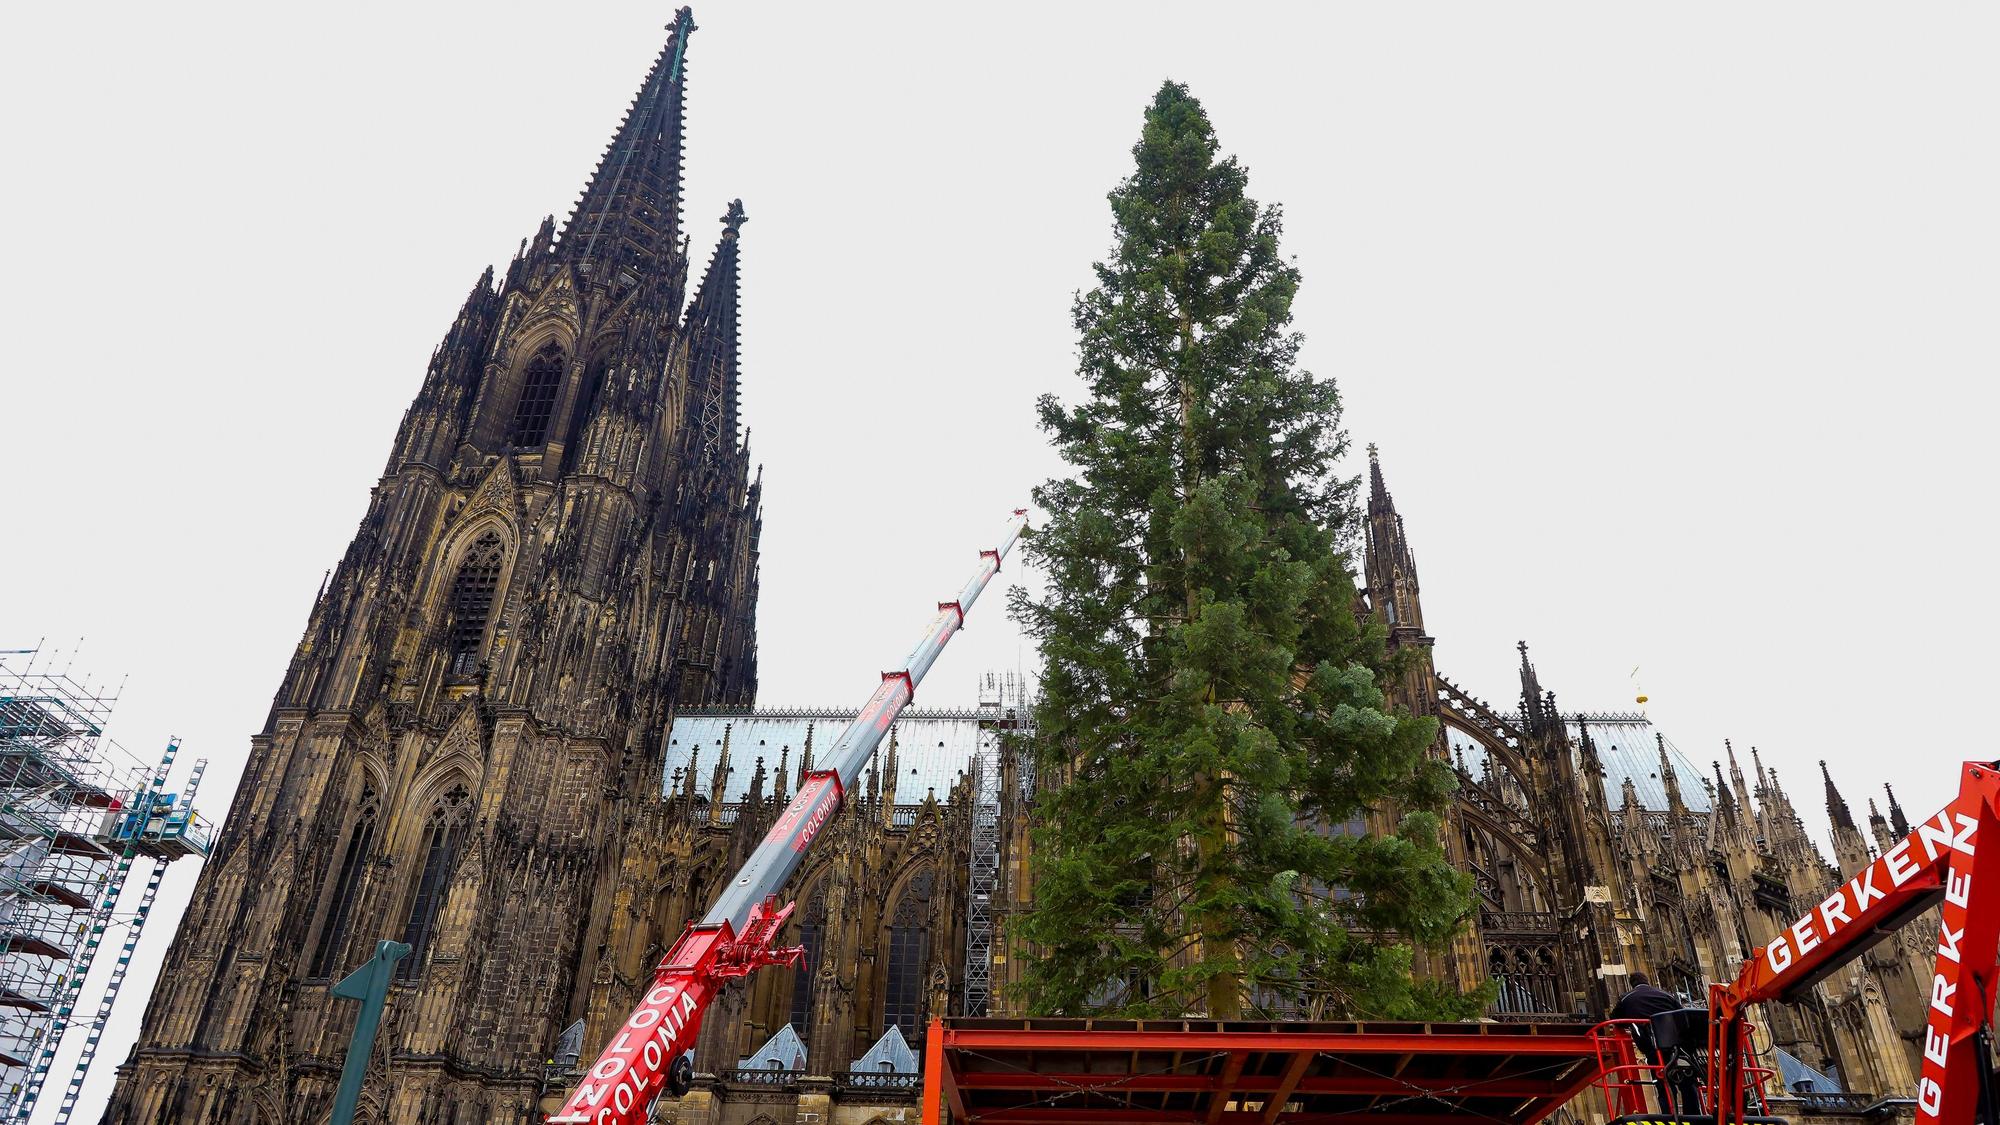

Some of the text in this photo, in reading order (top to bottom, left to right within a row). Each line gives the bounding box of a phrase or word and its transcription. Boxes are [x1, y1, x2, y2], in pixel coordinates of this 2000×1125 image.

[802, 791, 837, 843] COLONIA
[1767, 809, 1954, 975] GERKEN
[1917, 812, 1979, 1117] GERKEN
[597, 990, 698, 1125] COLONIA
